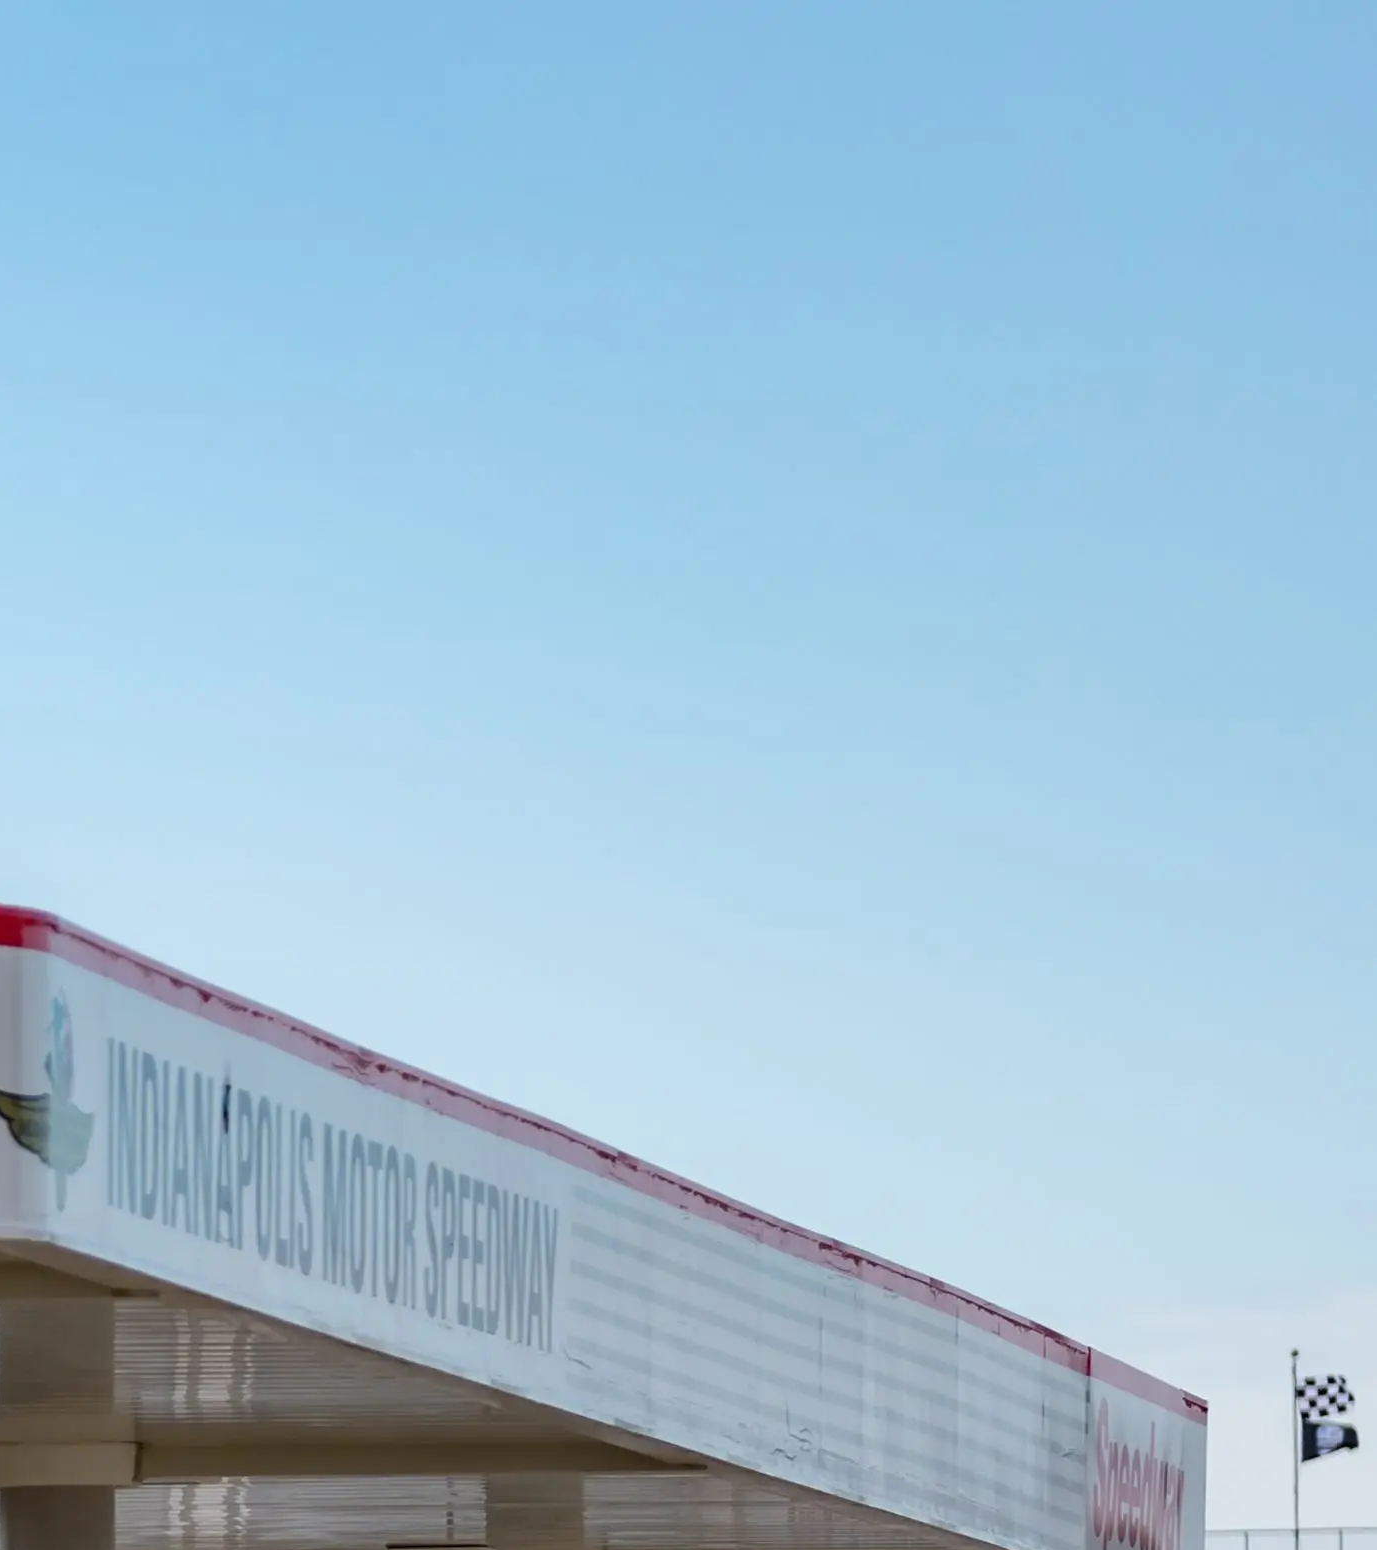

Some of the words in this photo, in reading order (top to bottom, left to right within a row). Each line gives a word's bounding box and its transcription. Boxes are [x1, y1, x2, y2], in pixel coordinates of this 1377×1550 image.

[107, 1037, 314, 1276] INDIANAPOLIS
[323, 1121, 417, 1310] MOTOR
[423, 1160, 559, 1354] SPEEDWAY
